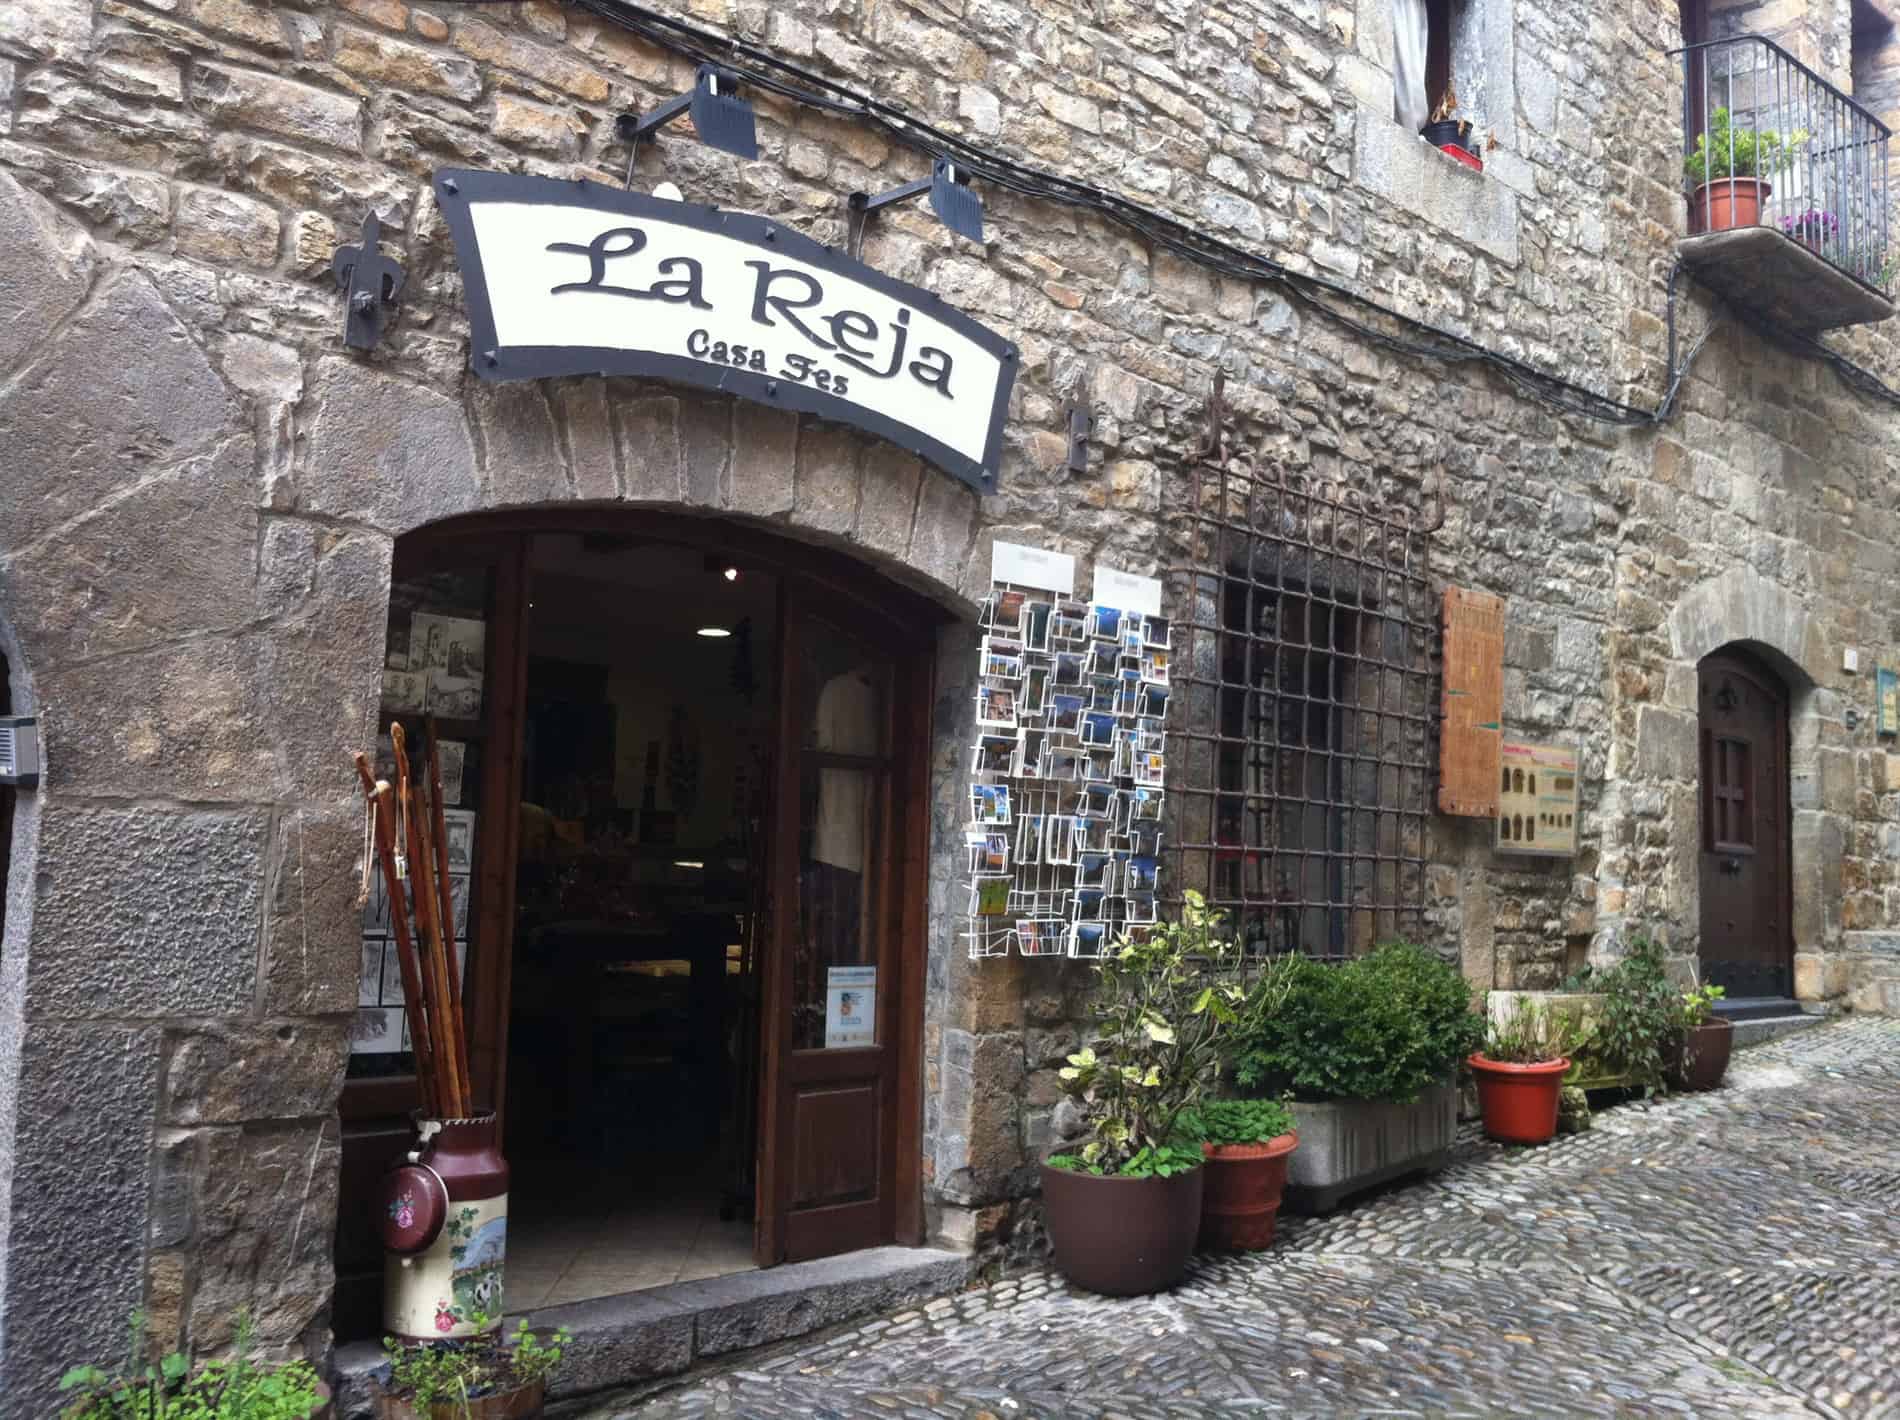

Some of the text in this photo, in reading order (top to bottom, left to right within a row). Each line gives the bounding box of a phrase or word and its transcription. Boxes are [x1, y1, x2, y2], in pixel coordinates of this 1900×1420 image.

[546, 227, 954, 400] La Reja
[687, 328, 849, 396] Casa Fes
